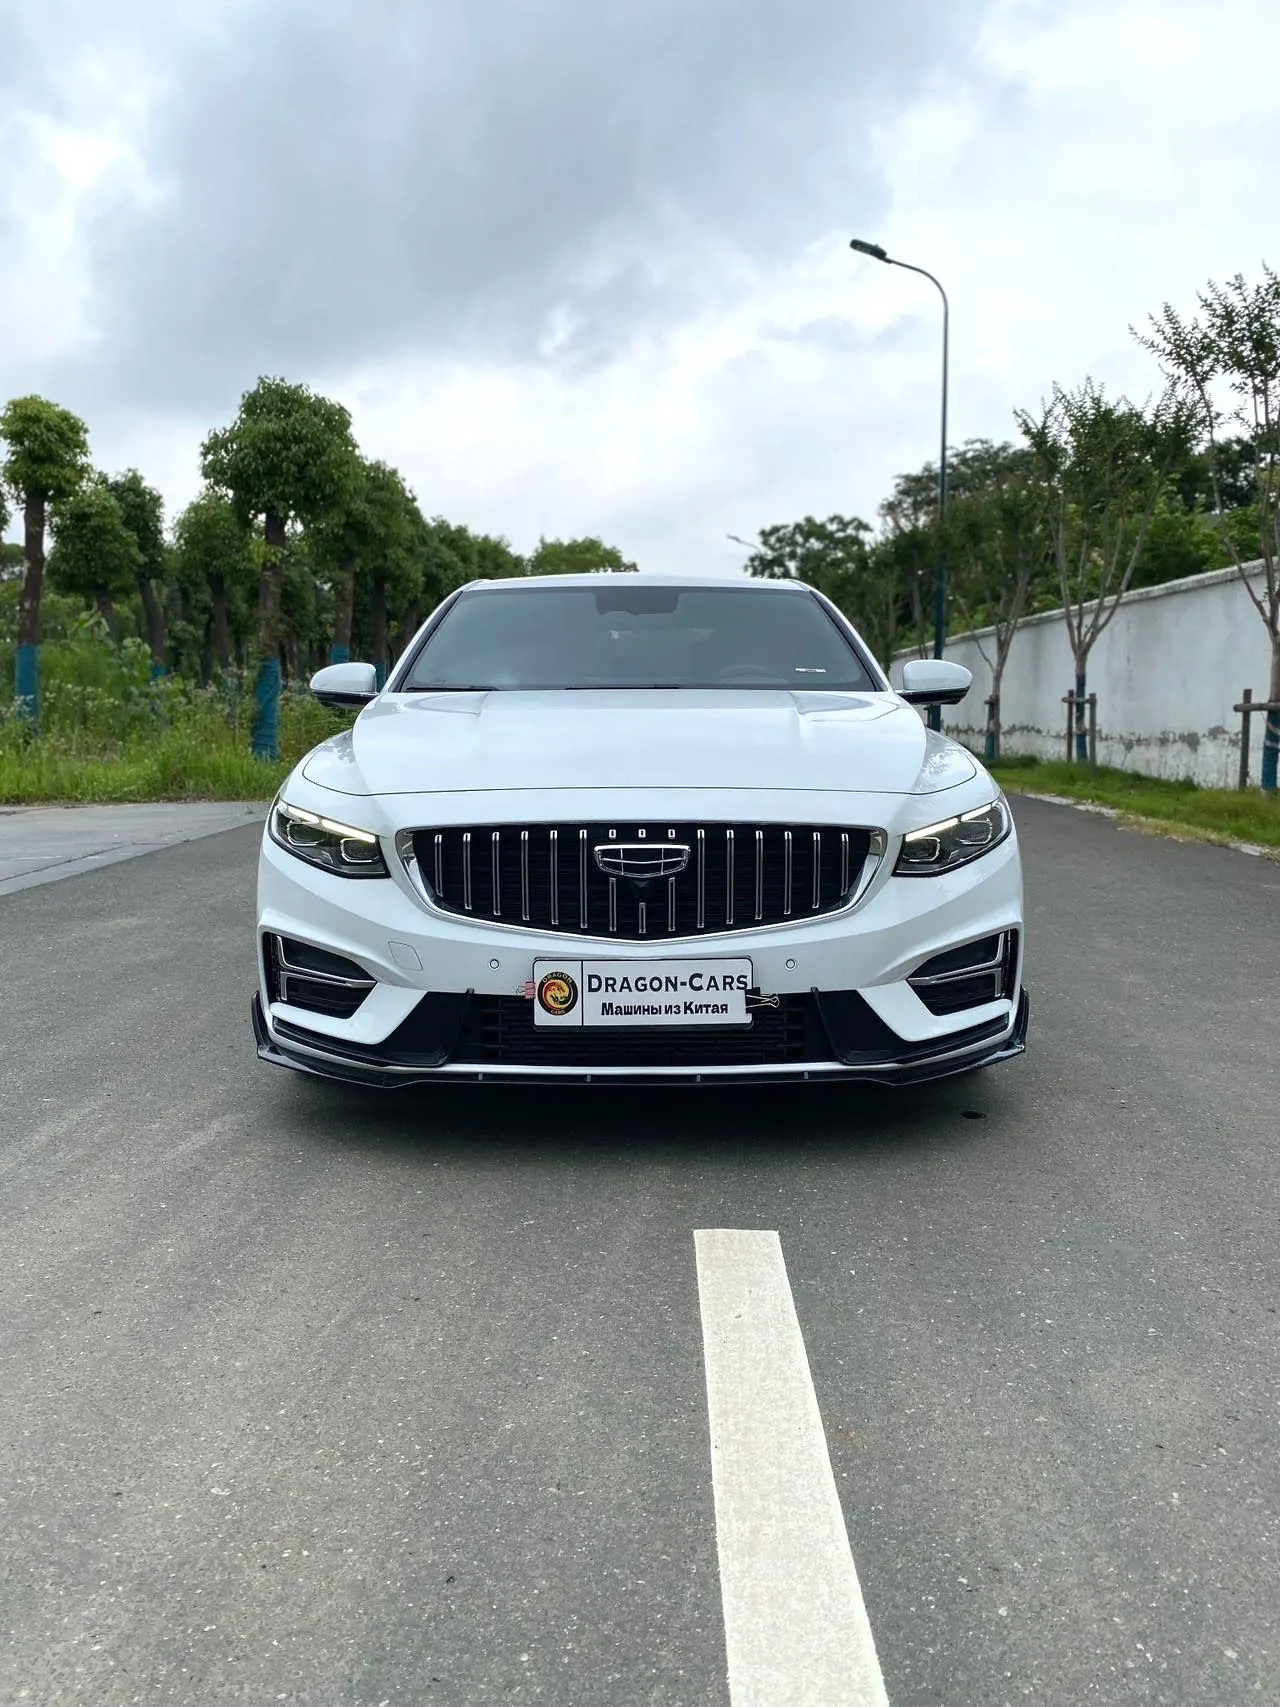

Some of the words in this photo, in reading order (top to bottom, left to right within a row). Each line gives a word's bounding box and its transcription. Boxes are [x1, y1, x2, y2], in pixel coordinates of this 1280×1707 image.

[542, 971, 573, 983] DRAGON
[587, 973, 748, 993] DRAGON-CARS
[601, 1001, 661, 1016] Машины
[664, 1004, 681, 1015] из
[683, 1001, 729, 1015] Китая
